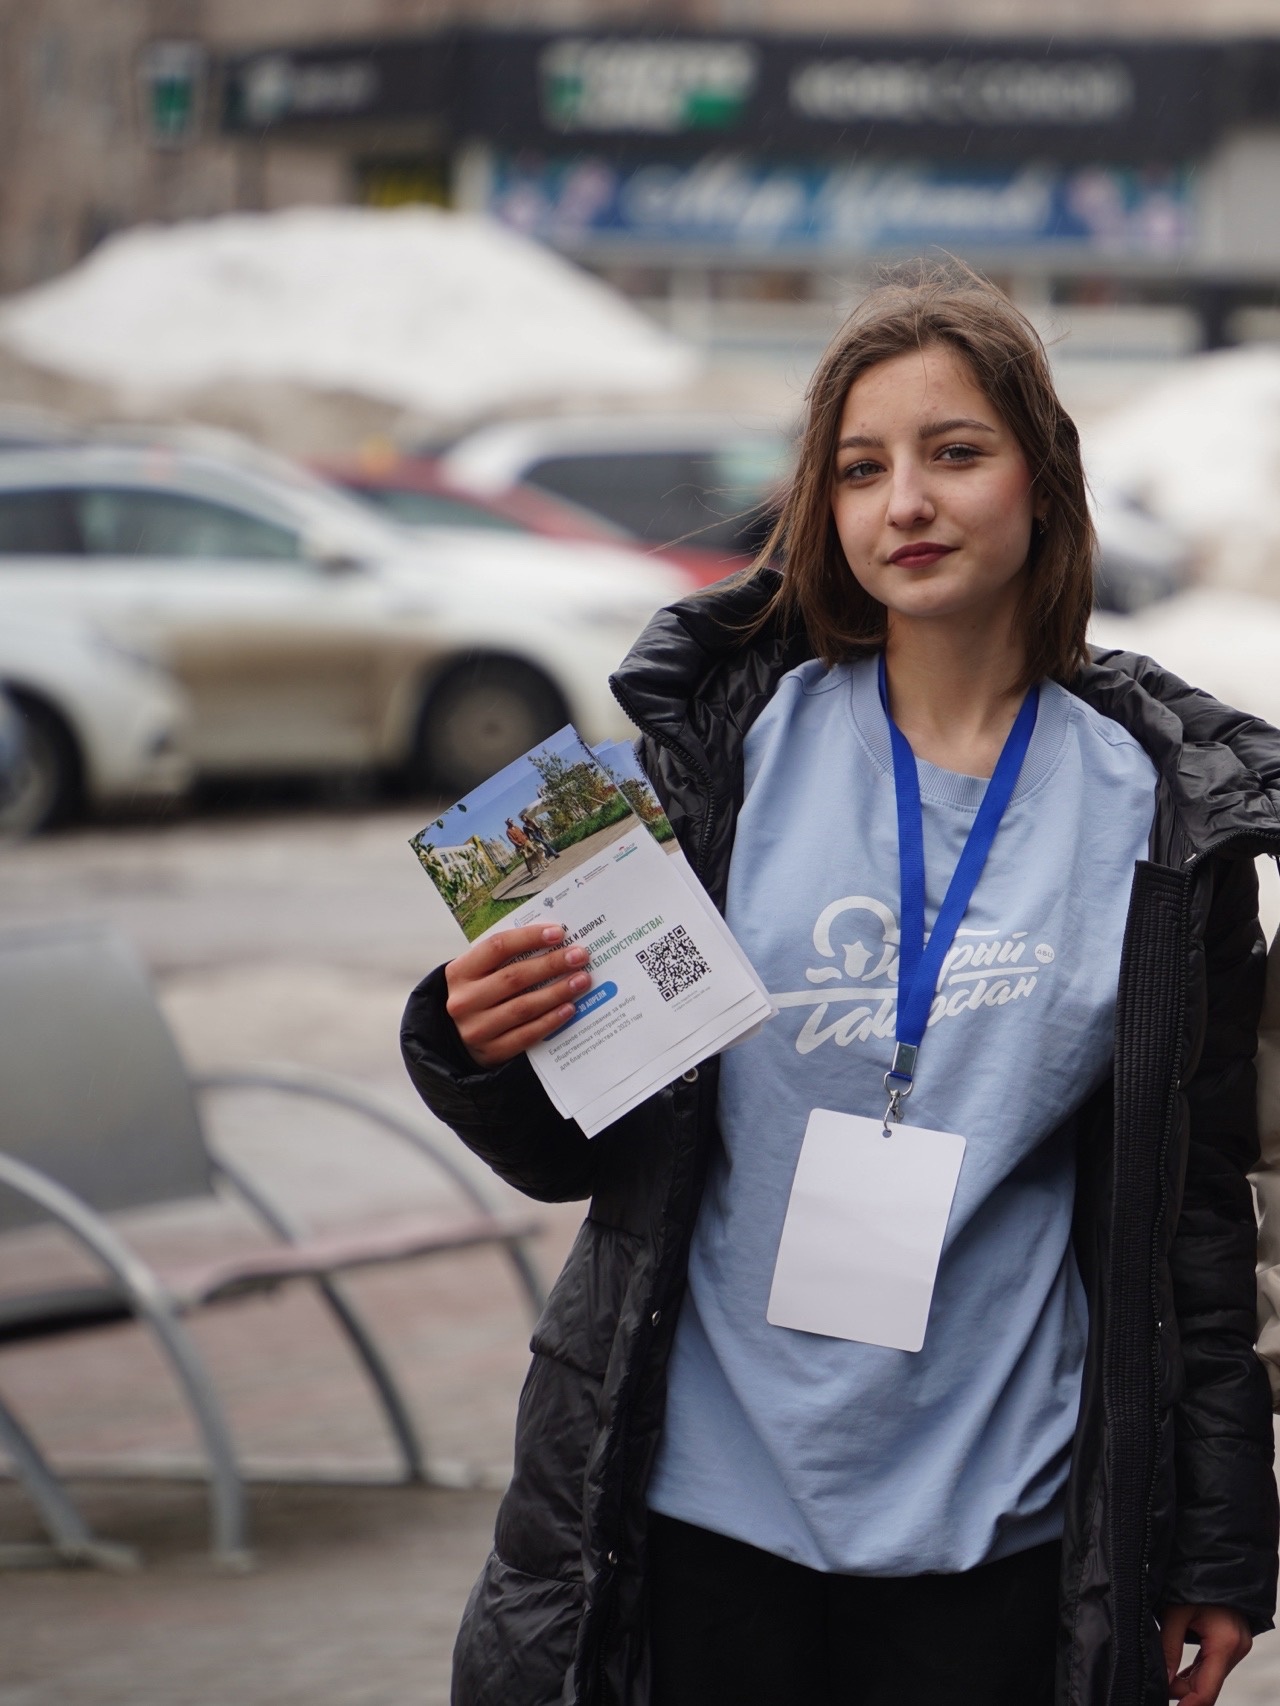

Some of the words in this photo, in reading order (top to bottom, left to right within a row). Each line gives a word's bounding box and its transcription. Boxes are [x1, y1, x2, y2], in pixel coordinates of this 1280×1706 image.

[572, 932, 579, 940] И
[577, 913, 607, 937] ДВОРАХ?
[592, 914, 664, 968] БЛАГОУСТРОЙСТВА!
[584, 988, 607, 1008] АПРЕЛЯ
